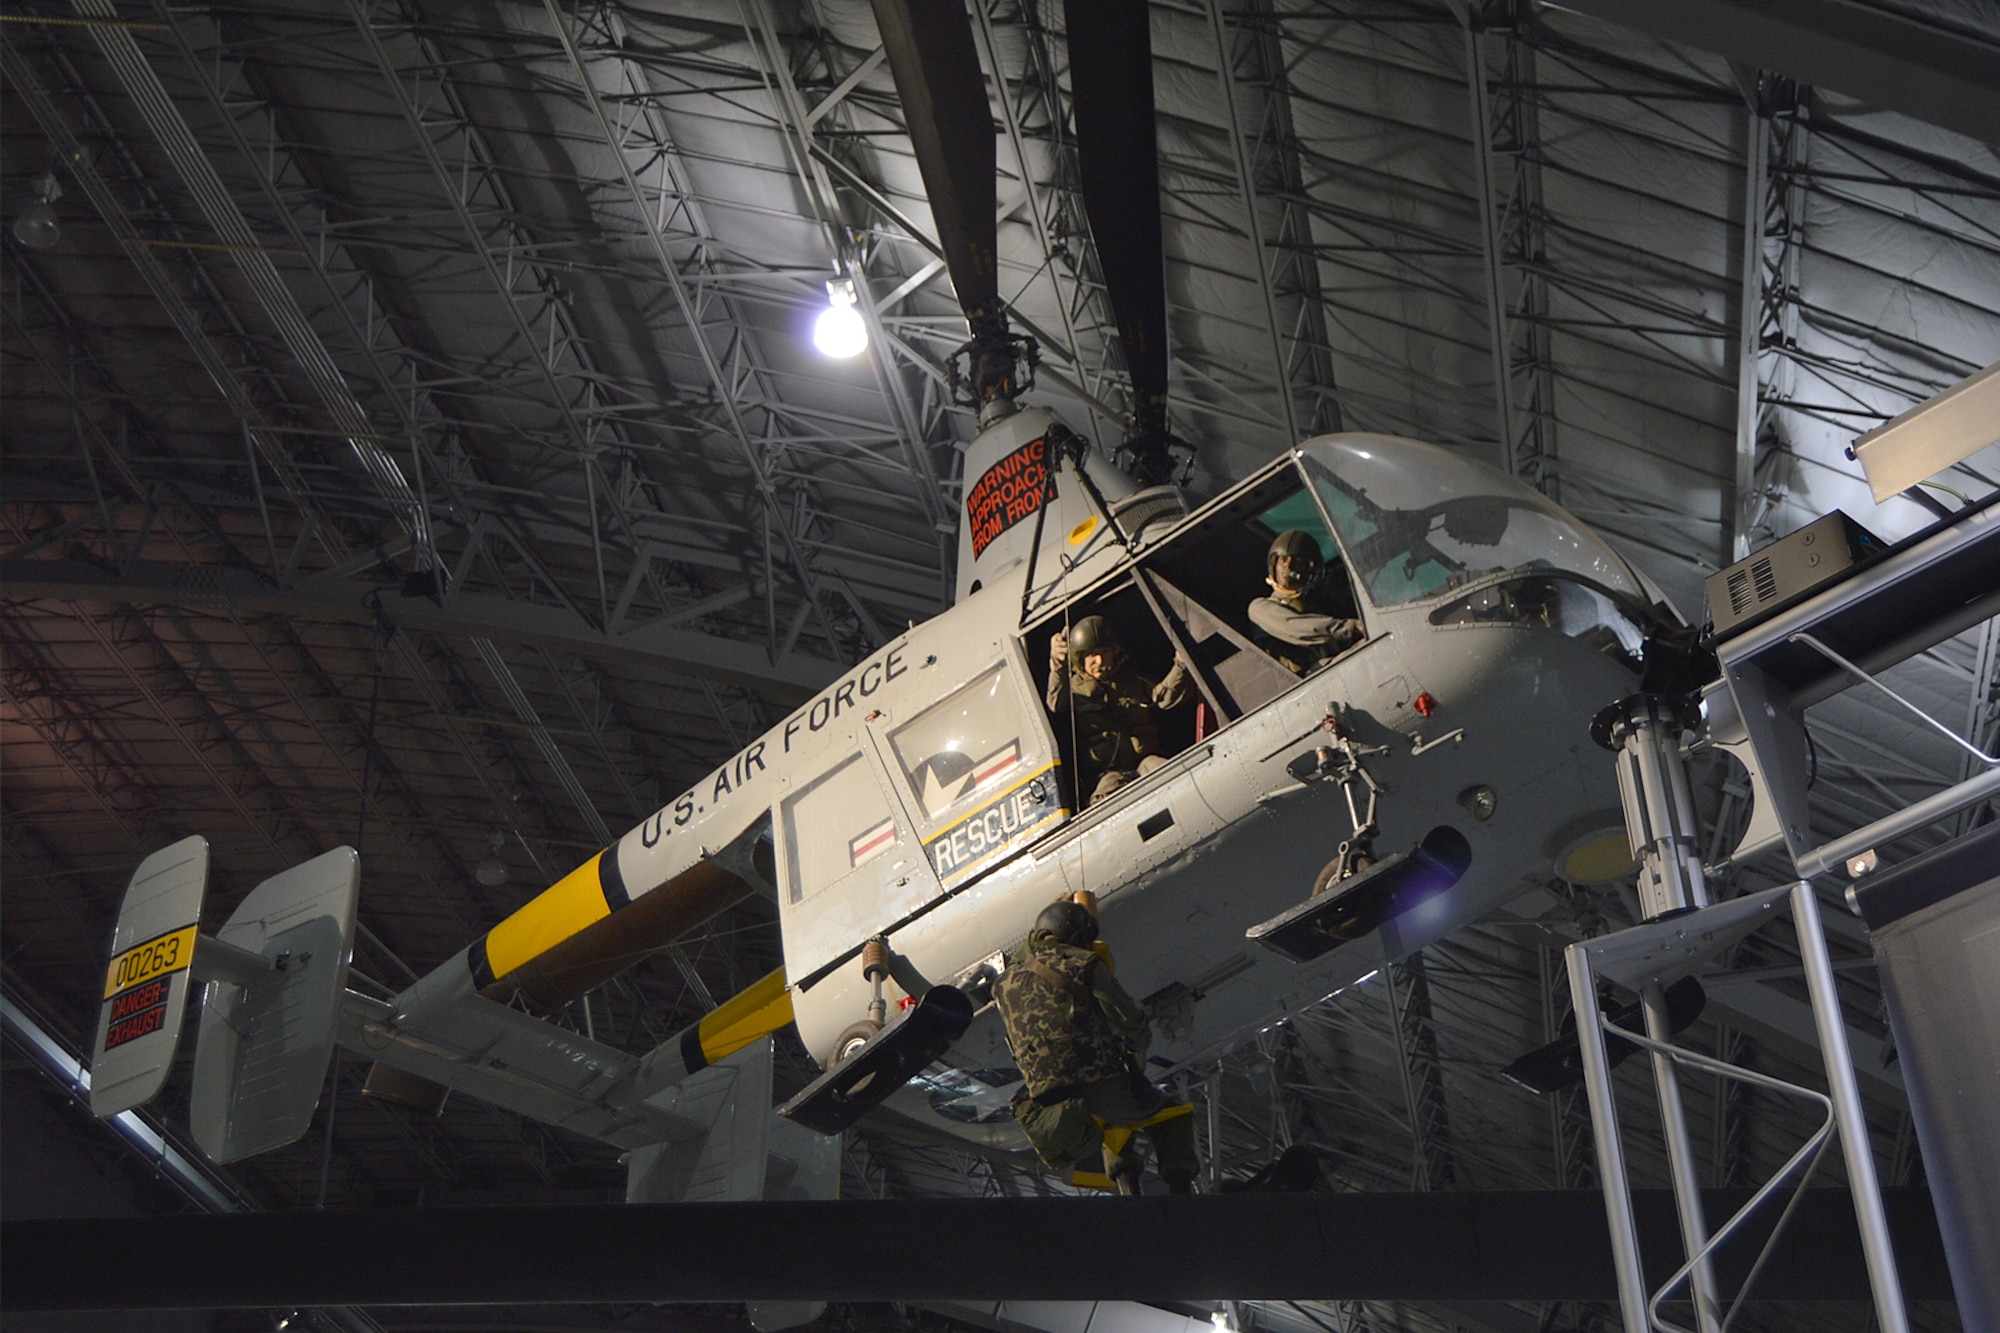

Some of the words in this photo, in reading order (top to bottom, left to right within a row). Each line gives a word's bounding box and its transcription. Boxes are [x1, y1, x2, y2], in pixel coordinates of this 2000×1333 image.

[967, 440, 1044, 514] WARNING
[972, 463, 1046, 536] APPROACH
[974, 512, 1003, 557] FROM
[1006, 484, 1054, 525] FRON
[642, 791, 704, 849] U.S.
[713, 741, 766, 803] AIR
[784, 641, 908, 753] FORCE
[933, 784, 1037, 873] RESCUE
[116, 937, 179, 988] 00263
[106, 1007, 165, 1049] EXHAUST
[111, 982, 168, 1020] DANGER-
